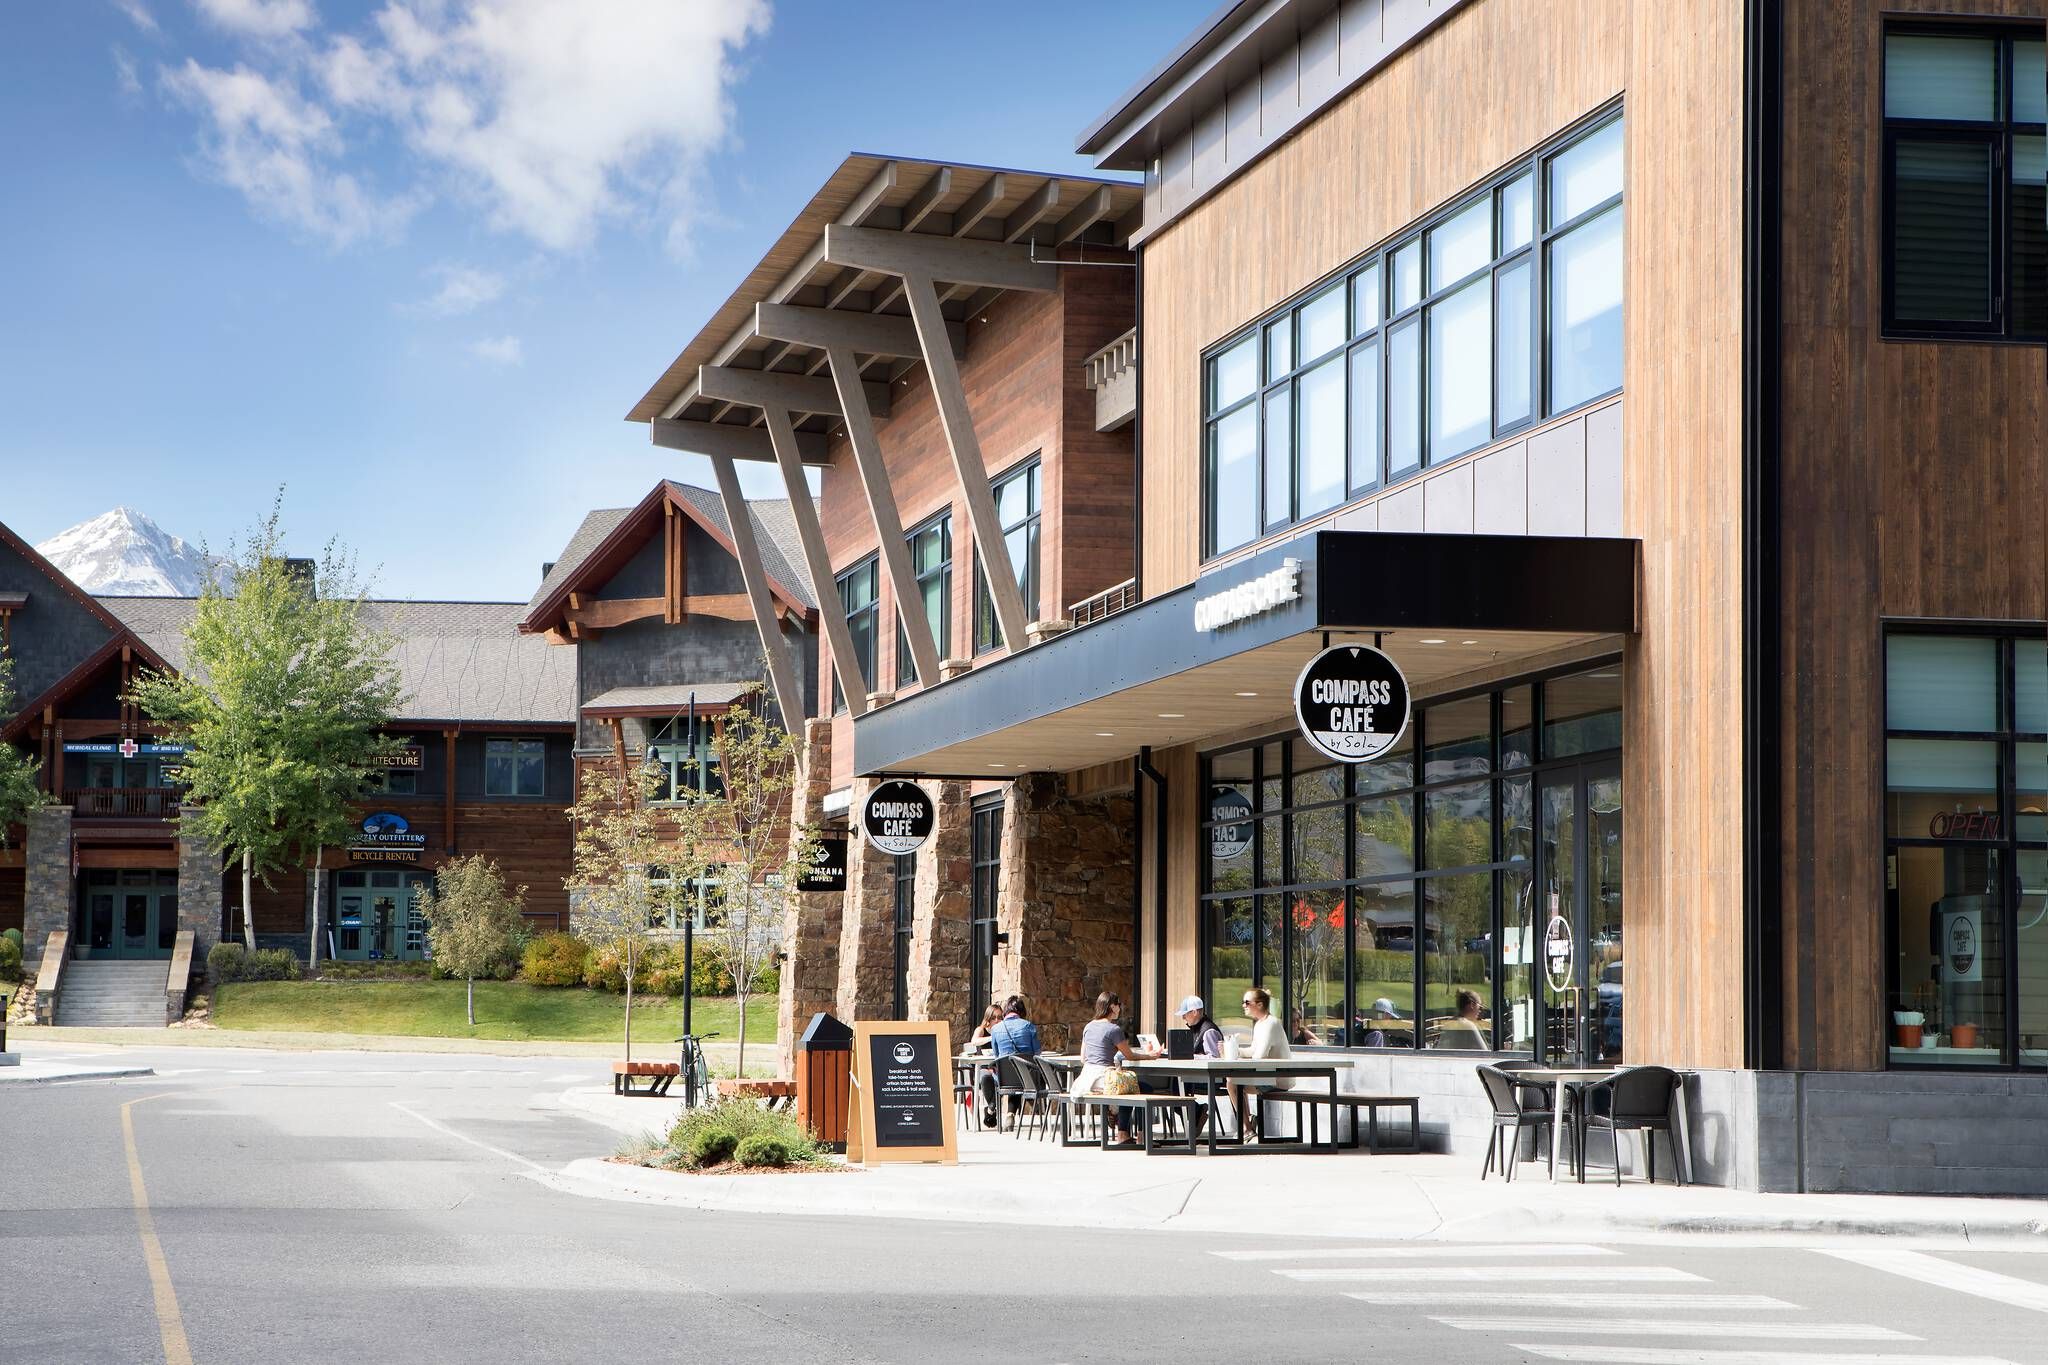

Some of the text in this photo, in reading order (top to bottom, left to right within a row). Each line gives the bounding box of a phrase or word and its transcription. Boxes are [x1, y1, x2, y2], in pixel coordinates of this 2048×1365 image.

[1312, 679, 1391, 705] COMPASS
[1330, 704, 1374, 732] CAFÉ
[1331, 735, 1378, 749] by Sola
[351, 757, 419, 765] HITECTURE
[872, 802, 923, 818] COMPASS
[884, 818, 912, 836] CAFÉ
[1929, 811, 2000, 840] OPEN
[379, 834, 425, 842] OUTFITTERS
[353, 852, 416, 860] BICYCLE RENTAL
[809, 867, 843, 875] ONTANA
